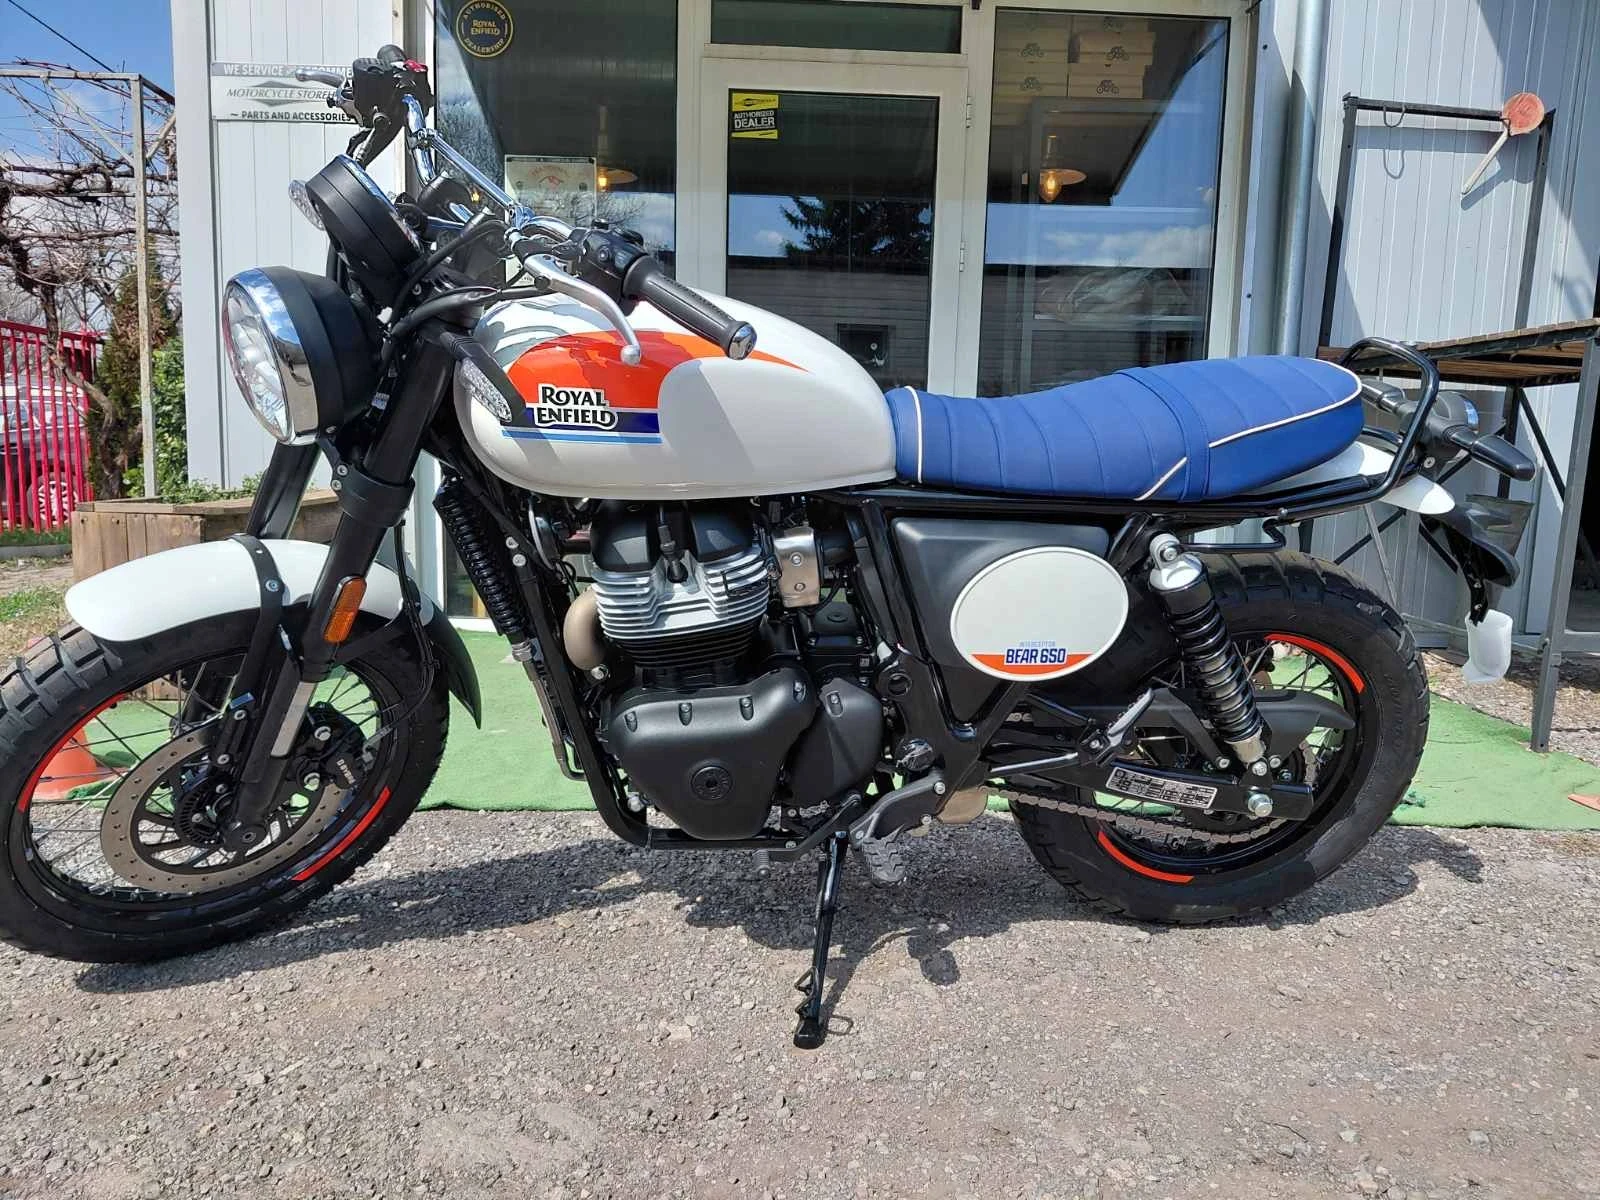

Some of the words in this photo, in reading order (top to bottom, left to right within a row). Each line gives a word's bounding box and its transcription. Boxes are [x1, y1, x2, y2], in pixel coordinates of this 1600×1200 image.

[223, 63, 240, 75] WE
[243, 64, 284, 76] SERVICE
[227, 87, 294, 99] MOTORCYCLE
[295, 89, 337, 99] STOREH
[241, 111, 270, 120] PARTS
[271, 111, 291, 121] AND
[292, 112, 351, 122] ACCESSORIES
[734, 117, 776, 129] DEALER
[541, 385, 607, 407] ROYAL
[537, 406, 616, 426] ENFIELD
[1005, 648, 1038, 664] BEAR
[1040, 647, 1066, 664] 650
